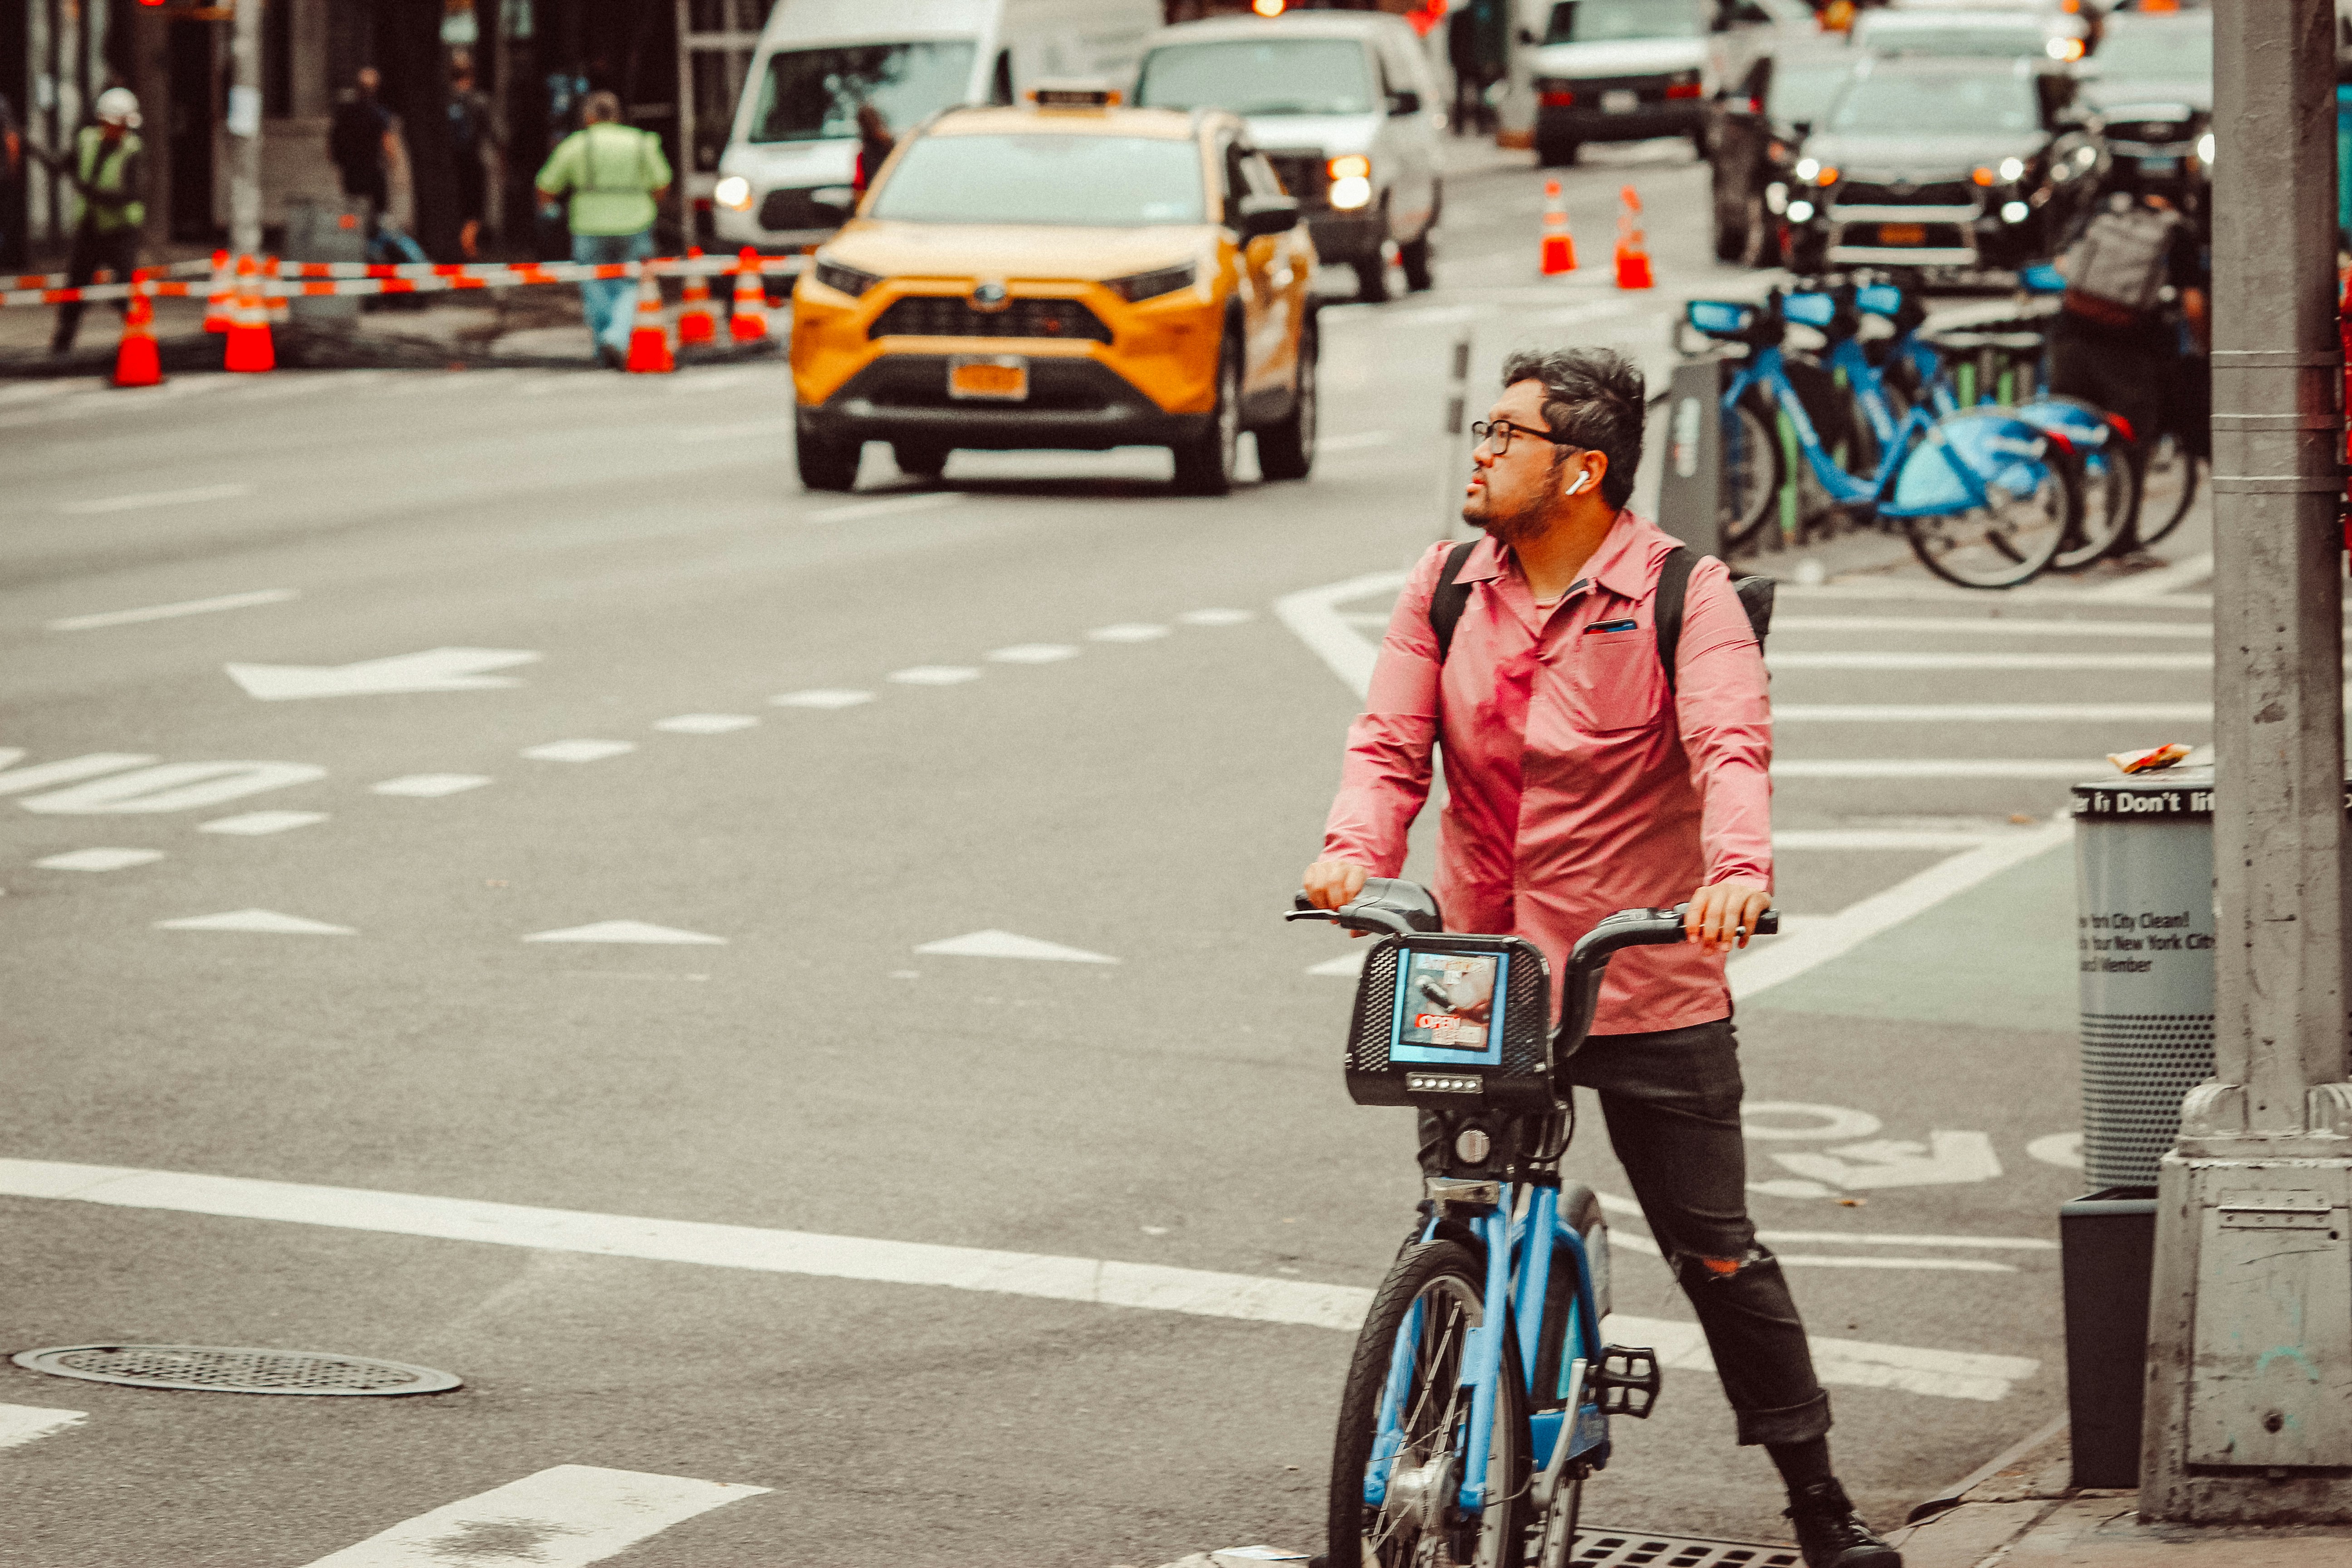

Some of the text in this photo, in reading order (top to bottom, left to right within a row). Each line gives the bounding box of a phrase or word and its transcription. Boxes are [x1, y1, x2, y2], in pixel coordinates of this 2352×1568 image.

[2116, 792, 2181, 813] Don't
[2112, 913, 2135, 932] City
[2140, 911, 2189, 928] Clean!
[2114, 936, 2142, 950] New
[2148, 934, 2182, 950] York
[2102, 957, 2152, 972] Member
